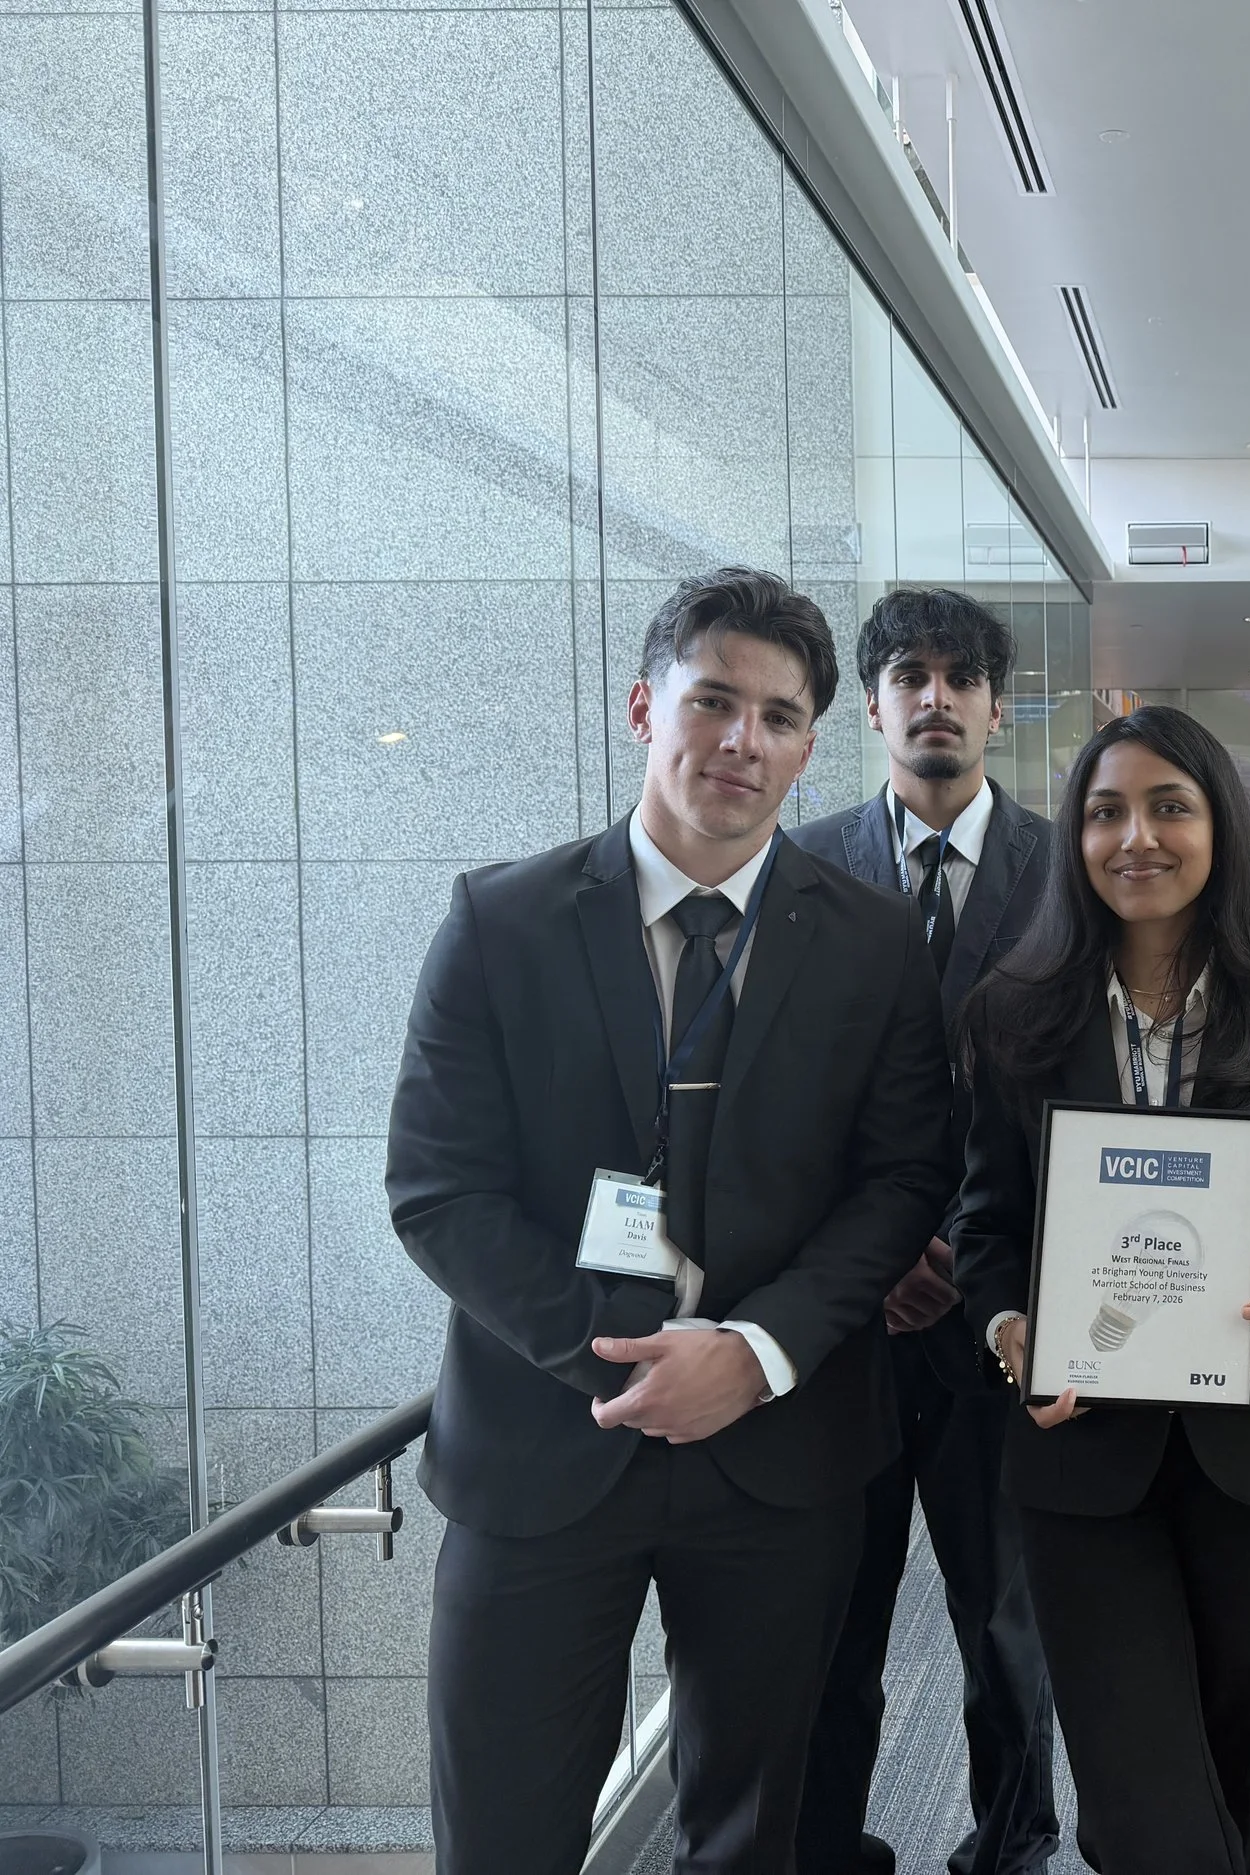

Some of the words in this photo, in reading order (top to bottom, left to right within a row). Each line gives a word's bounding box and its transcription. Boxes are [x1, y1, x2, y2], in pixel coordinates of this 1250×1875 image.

[1134, 1076, 1142, 1092] BYU
[1105, 1156, 1158, 1179] VCIC
[625, 1193, 646, 1205] VCIC
[624, 1217, 655, 1231] LIAM
[627, 1231, 647, 1241] Davis
[1121, 1234, 1141, 1249] 3rd
[1144, 1237, 1182, 1251] Place
[618, 1248, 647, 1259] Dogwood
[1091, 1267, 1100, 1275] at
[1102, 1267, 1136, 1277] Brigham
[1139, 1269, 1164, 1279] Young
[1166, 1270, 1208, 1281] University
[1092, 1279, 1127, 1288] Marriott
[1130, 1281, 1157, 1290] School
[1159, 1282, 1168, 1290] of
[1170, 1283, 1206, 1292] Business
[1113, 1293, 1150, 1304] February
[1152, 1295, 1160, 1304] 7,
[1162, 1295, 1183, 1304] 2026
[1076, 1360, 1101, 1370] UNC
[1190, 1373, 1226, 1386] BYU
